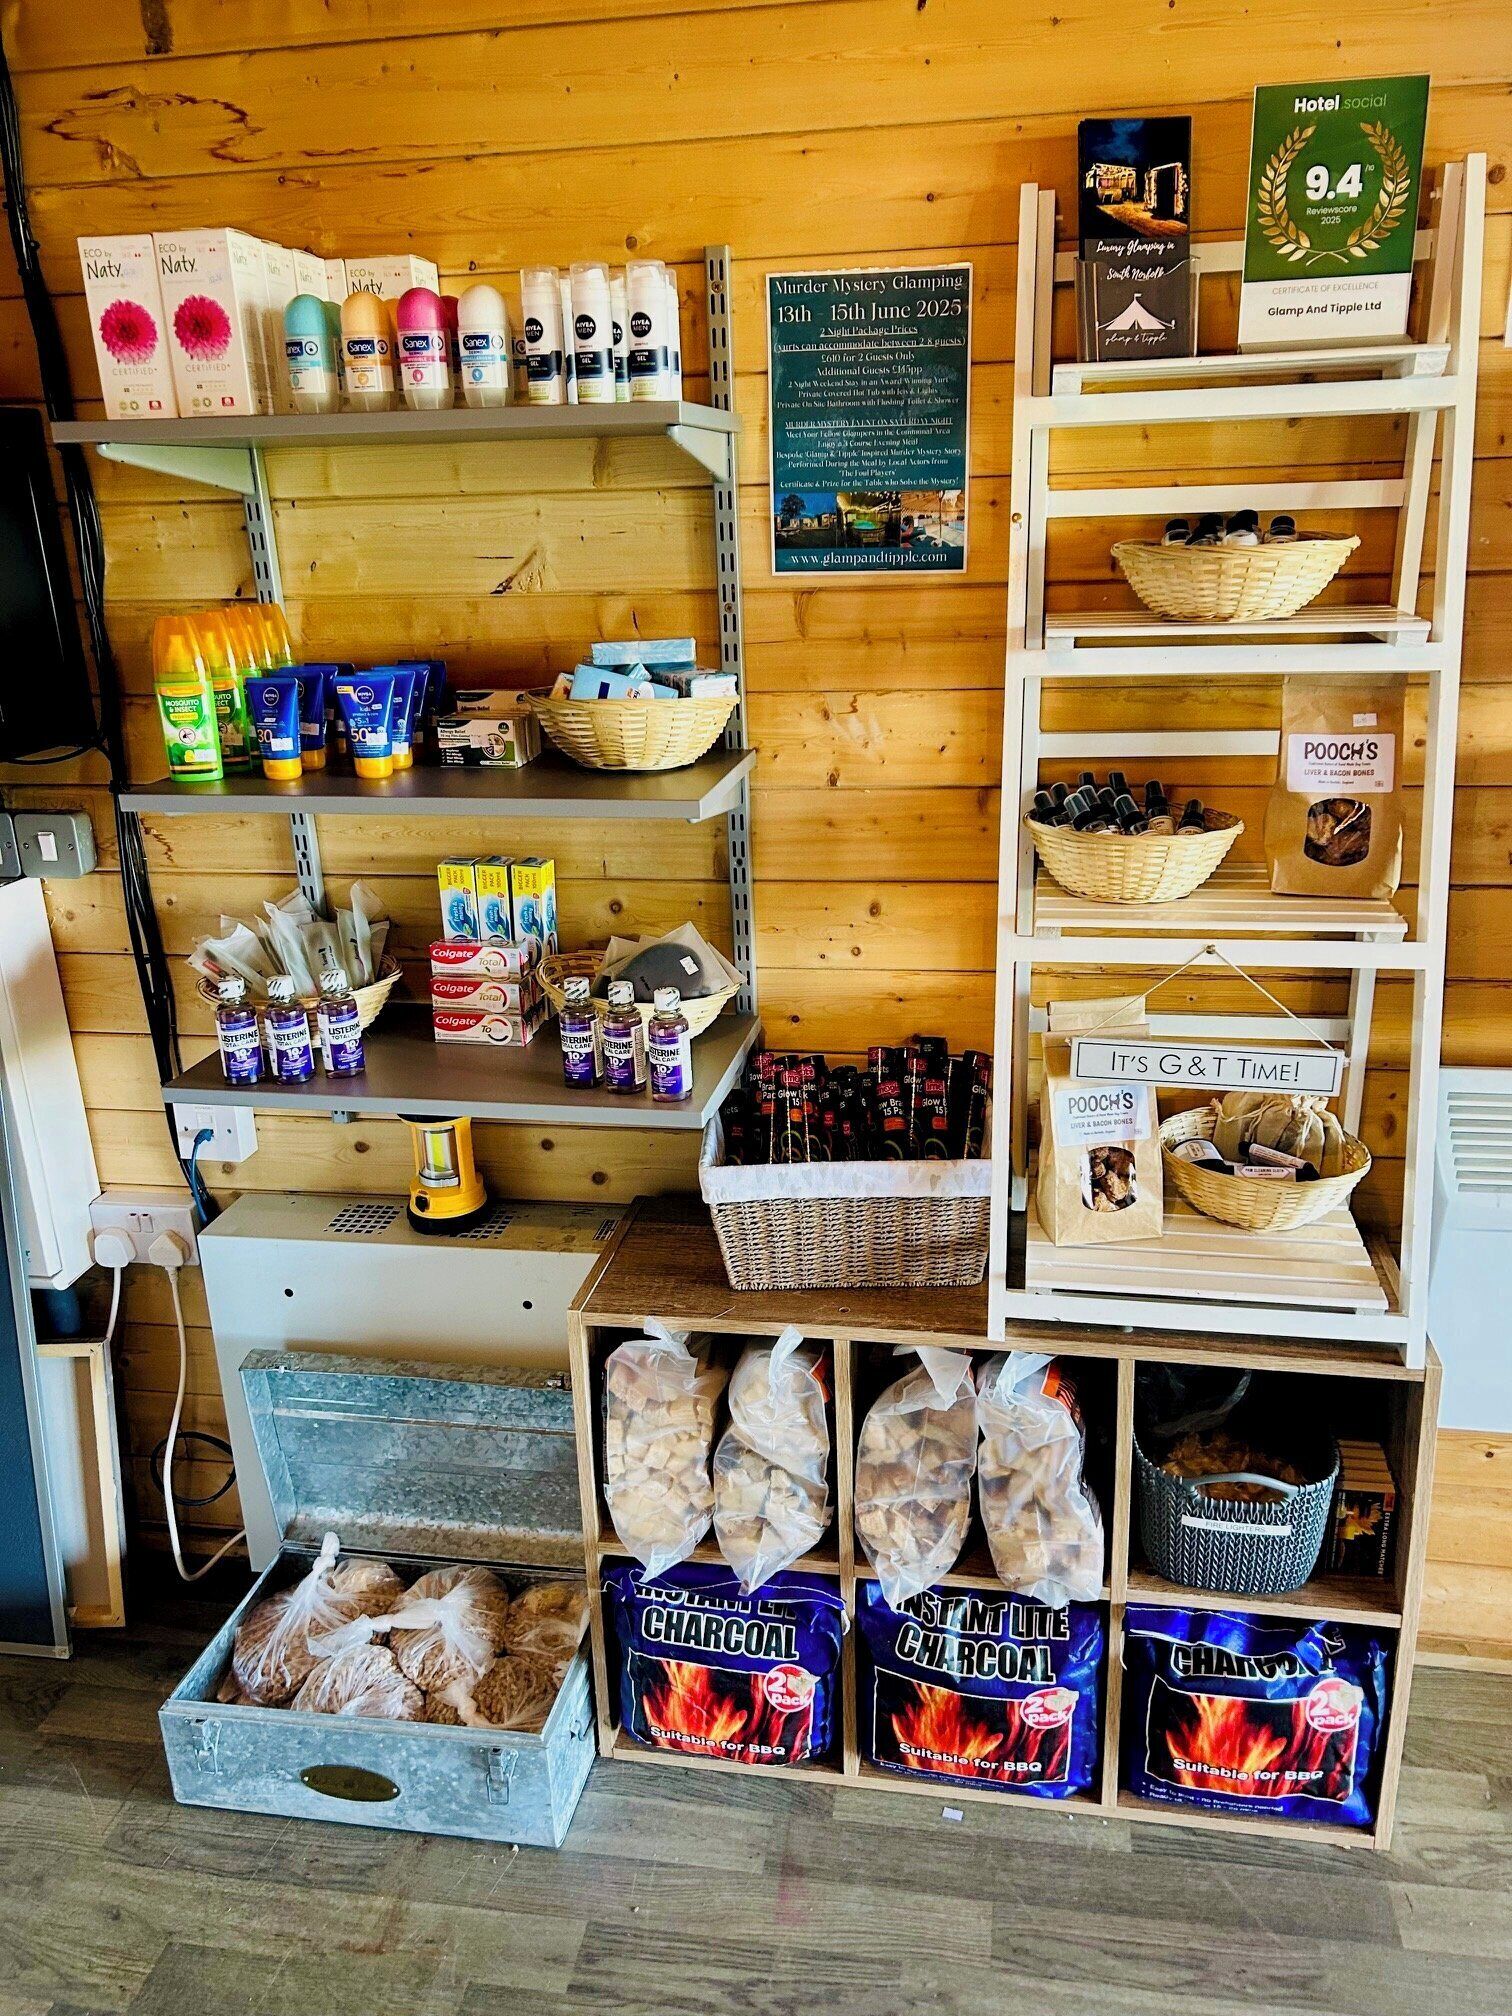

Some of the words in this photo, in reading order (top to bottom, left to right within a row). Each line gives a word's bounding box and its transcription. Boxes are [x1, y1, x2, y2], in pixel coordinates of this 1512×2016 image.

[1306, 164, 1362, 201] 9.4
[1307, 205, 1357, 215] Reviewscore
[1321, 216, 1341, 225] 2025
[84, 249, 102, 258] ECO
[159, 243, 176, 253] ECO
[179, 245, 187, 253] by
[1096, 241, 1125, 256] Luxury
[1127, 240, 1165, 256] Glamping
[350, 269, 366, 277] ECO
[1107, 267, 1130, 280] South
[1132, 267, 1165, 281] Norfolk
[776, 279, 828, 294] Murder
[833, 278, 887, 295] Mystery
[893, 275, 963, 291] Glamping
[1273, 283, 1318, 295] CERTIFICATE
[1320, 283, 1331, 292] OF
[1333, 281, 1379, 292] EXCELLENCE
[778, 305, 811, 323] 13th
[831, 303, 865, 320] 15th
[872, 303, 910, 321] June
[917, 299, 962, 317] 2025
[1268, 306, 1303, 317] Glamp
[1306, 304, 1328, 314] And
[1330, 302, 1362, 314] Tipple
[1365, 301, 1381, 311] Ltd
[349, 343, 373, 352] Sanex
[404, 339, 428, 348] Sanex
[464, 338, 487, 347] Sanex
[843, 353, 856, 362] for
[858, 353, 863, 361] 2
[866, 352, 893, 361] Guests
[896, 351, 915, 362] Only
[817, 366, 860, 376] Additional
[862, 366, 890, 374] Guests
[791, 550, 947, 566] www.glampandtipple.com
[258, 729, 272, 743] 30
[1304, 739, 1378, 760] POOCH'S
[432, 948, 474, 959] Colgate
[479, 957, 502, 966] Total
[433, 983, 474, 993] Colgate
[479, 992, 502, 1001] Total
[436, 1016, 477, 1026] Colgate
[222, 1030, 259, 1042] LISTERINE
[274, 1028, 307, 1041] LISTERINE
[609, 1057, 618, 1065] 10
[1111, 1051, 1148, 1073] IT'S
[1237, 1057, 1300, 1083] TIME!
[778, 1090, 797, 1098] Glow
[792, 1098, 800, 1106] 15
[922, 1098, 940, 1107] Glow
[1069, 1090, 1133, 1114] POOCH'S
[883, 1108, 892, 1116] 15
[935, 1106, 943, 1114] 15
[1226, 1523, 1266, 1532] LIGHTERS
[1010, 1602, 1070, 1640] LITE
[642, 1605, 799, 1660] CHARCOAL
[895, 1622, 1056, 1685] CHARCOAL
[1171, 1644, 1337, 1682] CHARCO
[771, 1691, 812, 1710] pack
[1027, 1708, 1071, 1724] pack
[1314, 1716, 1355, 1726] pack
[649, 1724, 717, 1749] Suitable
[720, 1738, 744, 1755] for
[749, 1744, 786, 1757] BBQ
[899, 1741, 969, 1766] Suitable
[972, 1758, 999, 1772] for
[1003, 1761, 1042, 1774] BBQ
[1173, 1758, 1249, 1781] Suitable
[1253, 1769, 1280, 1781] for
[1284, 1769, 1324, 1780] BBQ
